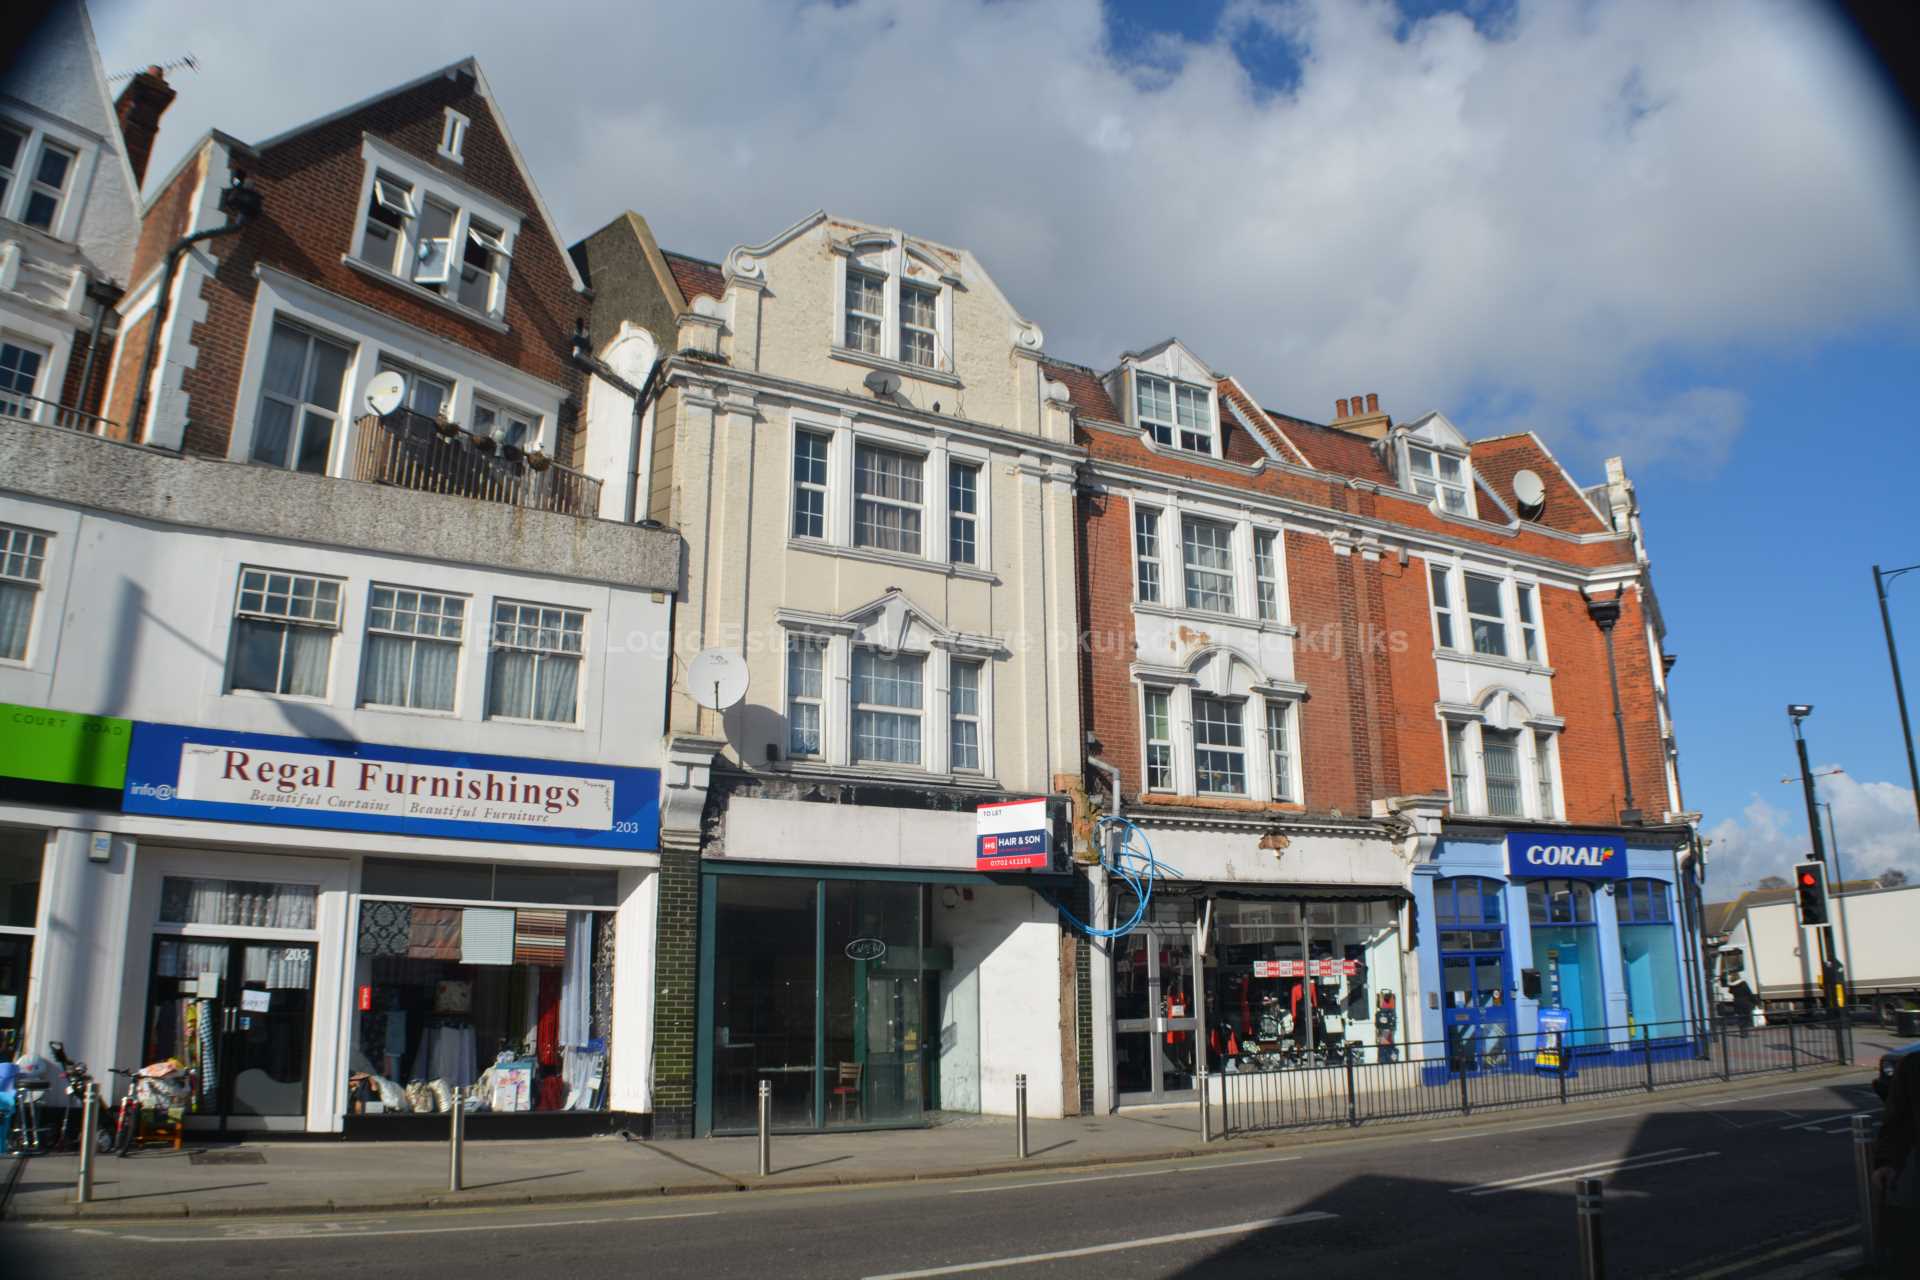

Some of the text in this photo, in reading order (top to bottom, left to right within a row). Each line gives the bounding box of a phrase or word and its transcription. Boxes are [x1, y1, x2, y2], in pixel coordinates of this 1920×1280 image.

[13, 712, 123, 736] COURT ROAD
[221, 750, 581, 814] Regal Furnishings
[250, 788, 391, 811] Beautiful Curtains
[409, 802, 549, 823] Beautiful Furniture
[998, 834, 1041, 847] HAIR & SON
[1526, 845, 1604, 866] CORAL
[284, 947, 310, 961] 203
